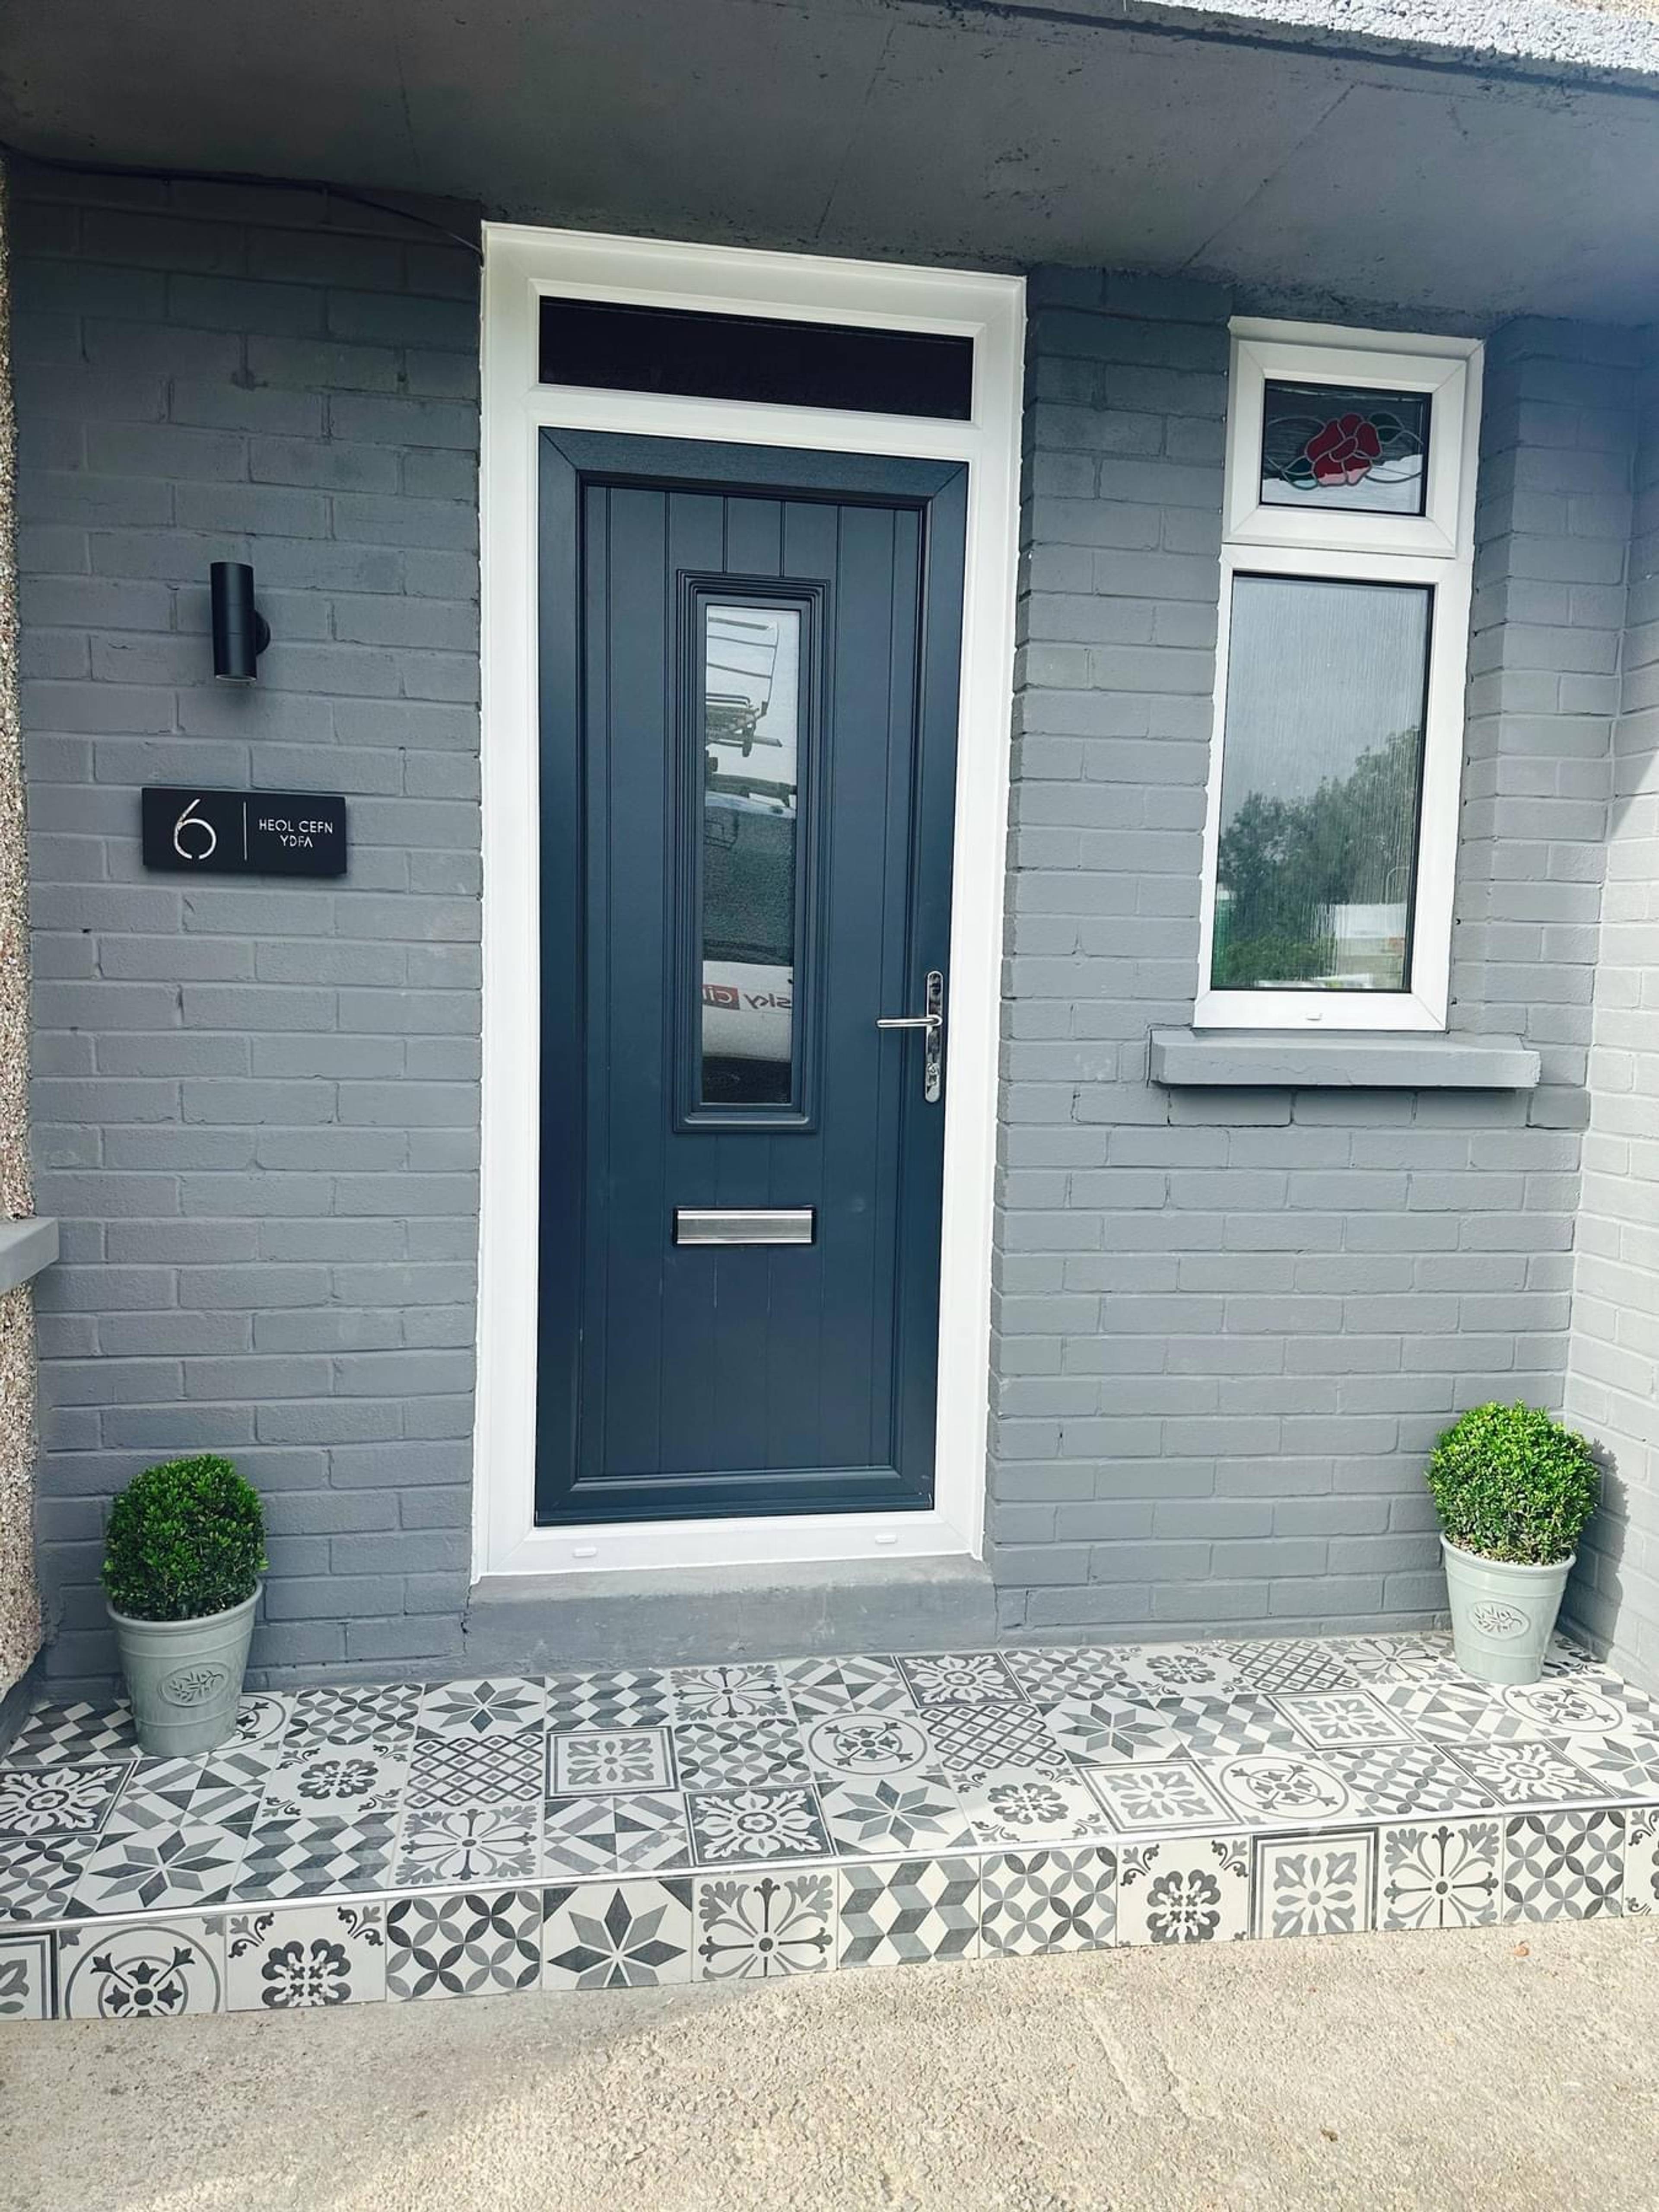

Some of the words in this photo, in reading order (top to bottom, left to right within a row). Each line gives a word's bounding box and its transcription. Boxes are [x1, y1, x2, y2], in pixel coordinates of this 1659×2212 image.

[174, 799, 216, 859] 6
[259, 819, 294, 832] HEOL
[298, 820, 333, 834] CEFN
[280, 834, 313, 848] YDFA
